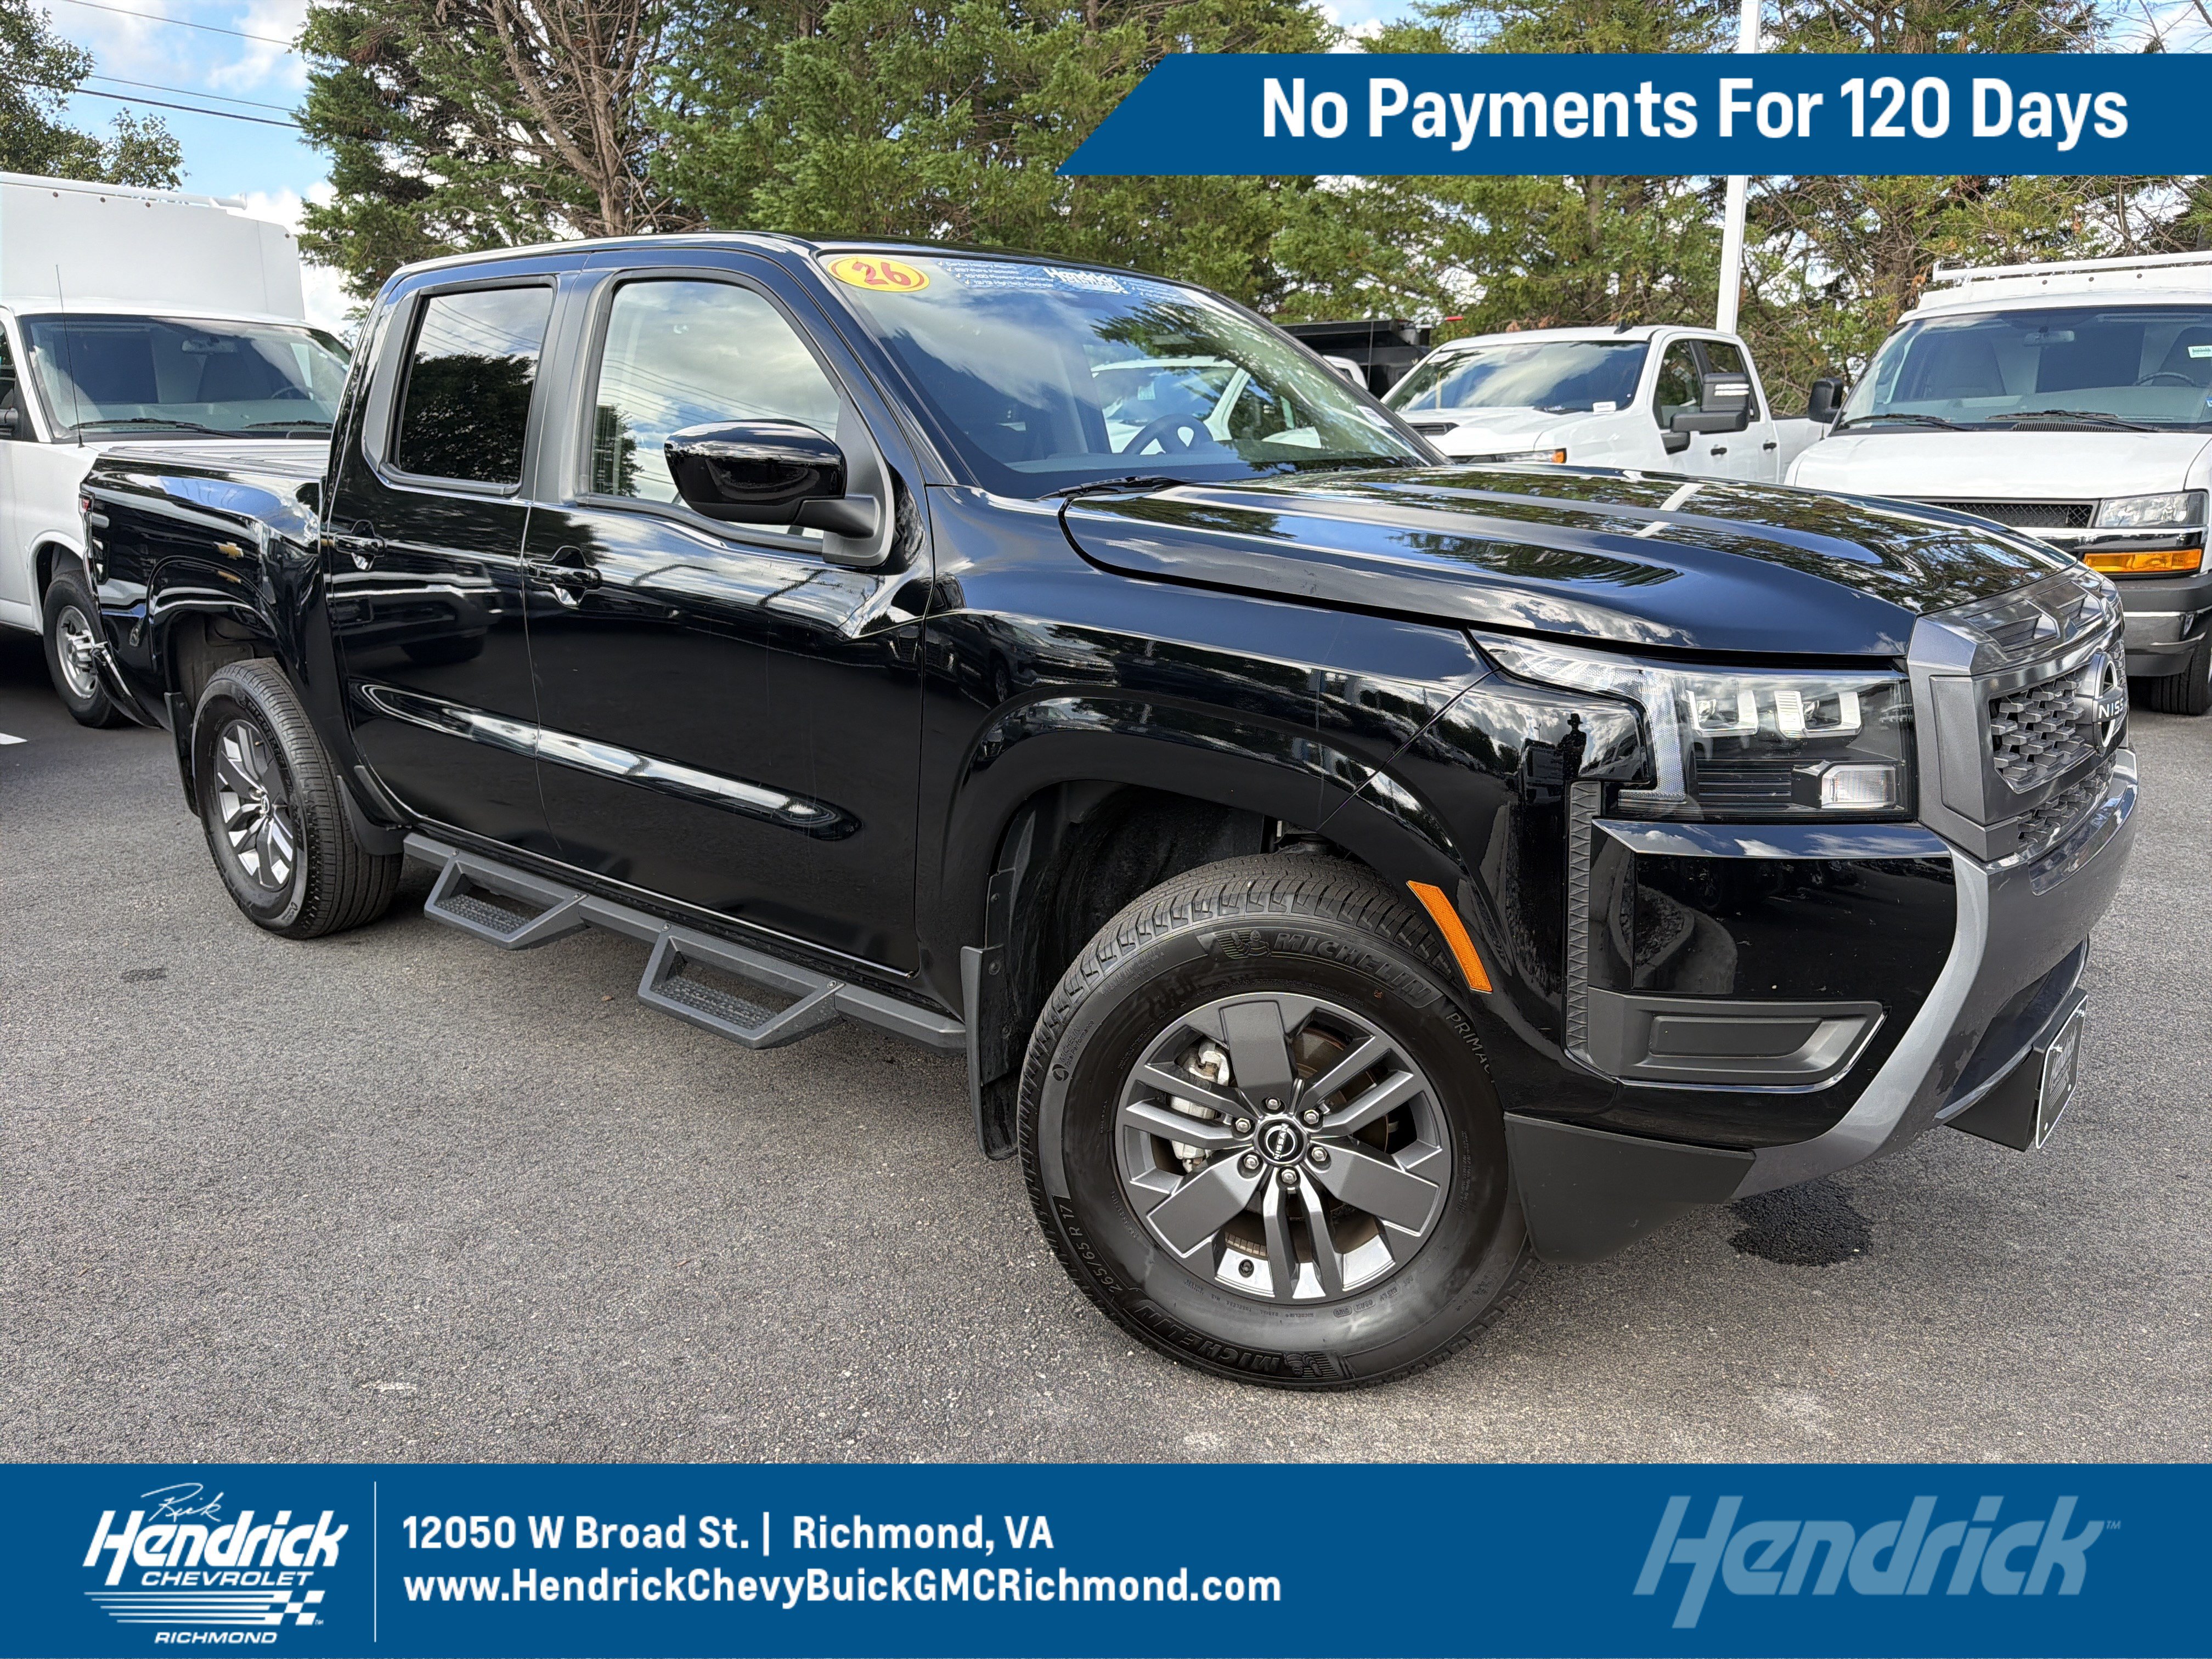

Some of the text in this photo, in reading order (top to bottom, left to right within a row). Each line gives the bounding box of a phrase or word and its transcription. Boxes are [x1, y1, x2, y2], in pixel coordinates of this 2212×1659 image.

[852, 261, 911, 286] 26
[1274, 933, 1431, 1002] MICHELIN
[1059, 1025, 1080, 1063] MICHELIN
[1274, 1123, 1289, 1160] NISSAN
[1059, 1204, 1123, 1293] 265/65 R 17
[1134, 1305, 1280, 1371] MICHELIN
